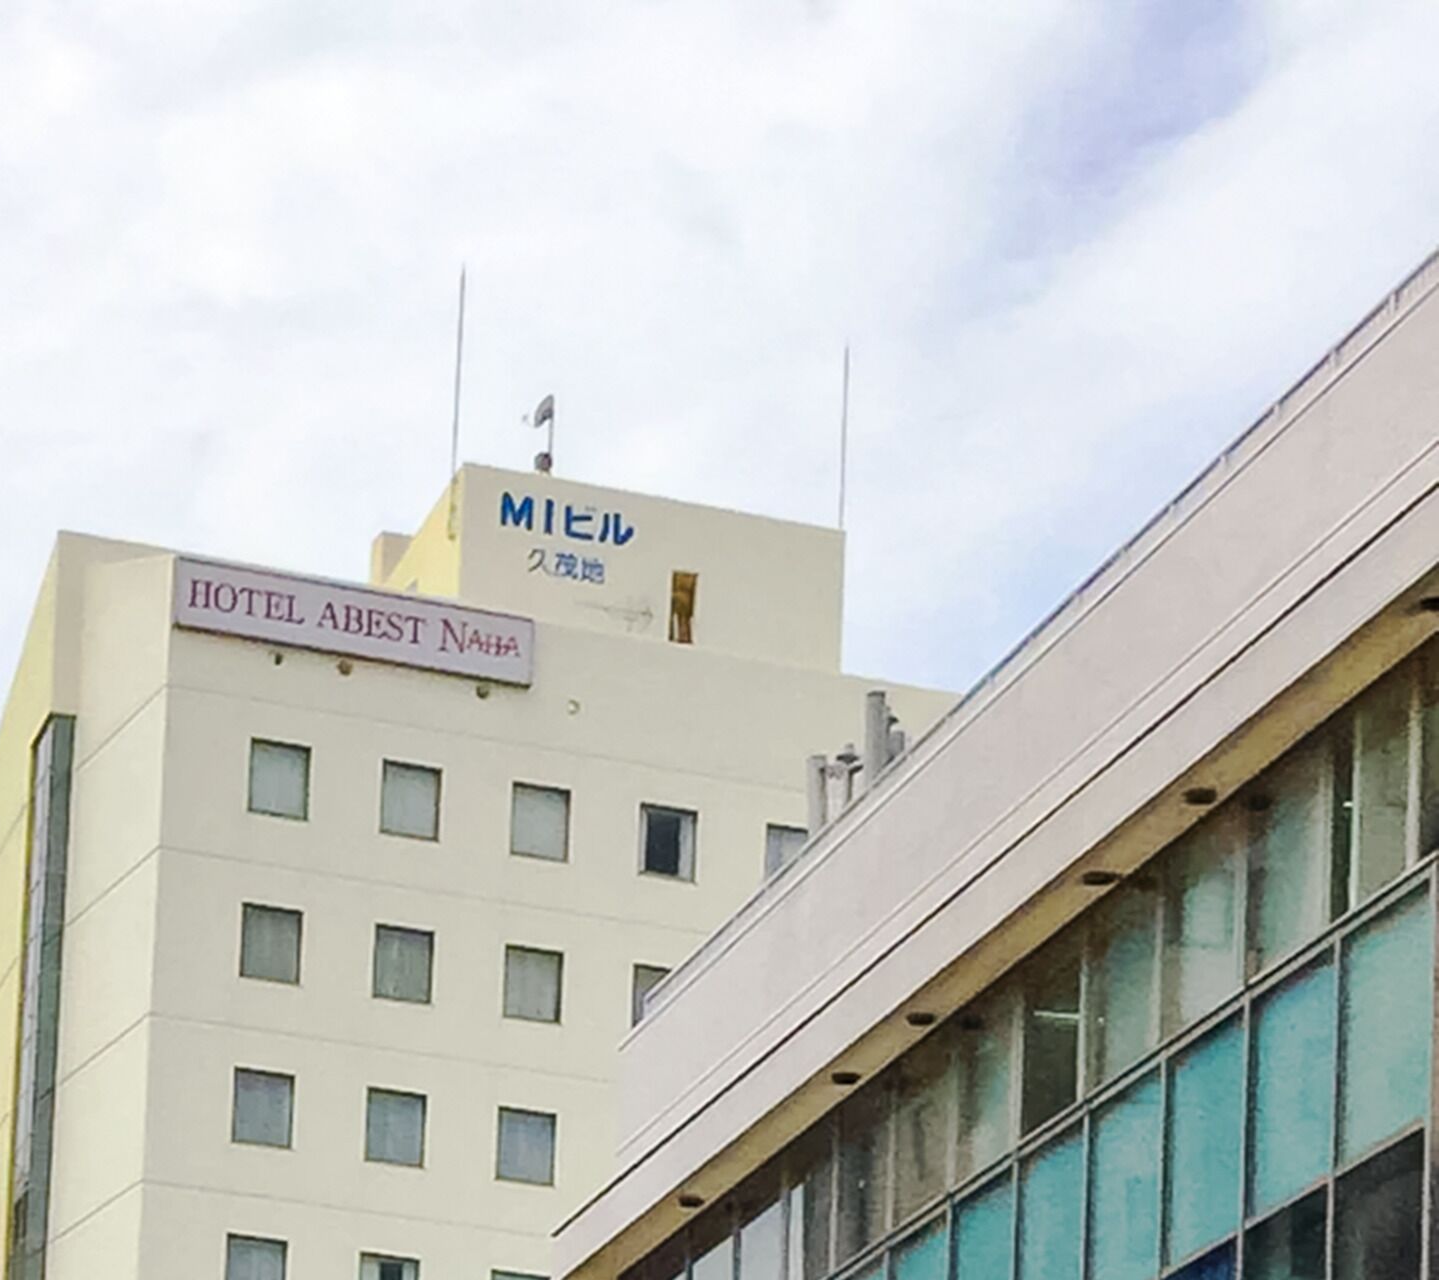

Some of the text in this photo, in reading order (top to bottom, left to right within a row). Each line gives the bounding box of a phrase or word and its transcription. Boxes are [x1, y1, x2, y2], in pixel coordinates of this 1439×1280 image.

[500, 490, 635, 546] MIビル
[527, 548, 605, 585] 久茂地
[187, 578, 305, 625] HOTEL
[315, 601, 428, 645] ABEST
